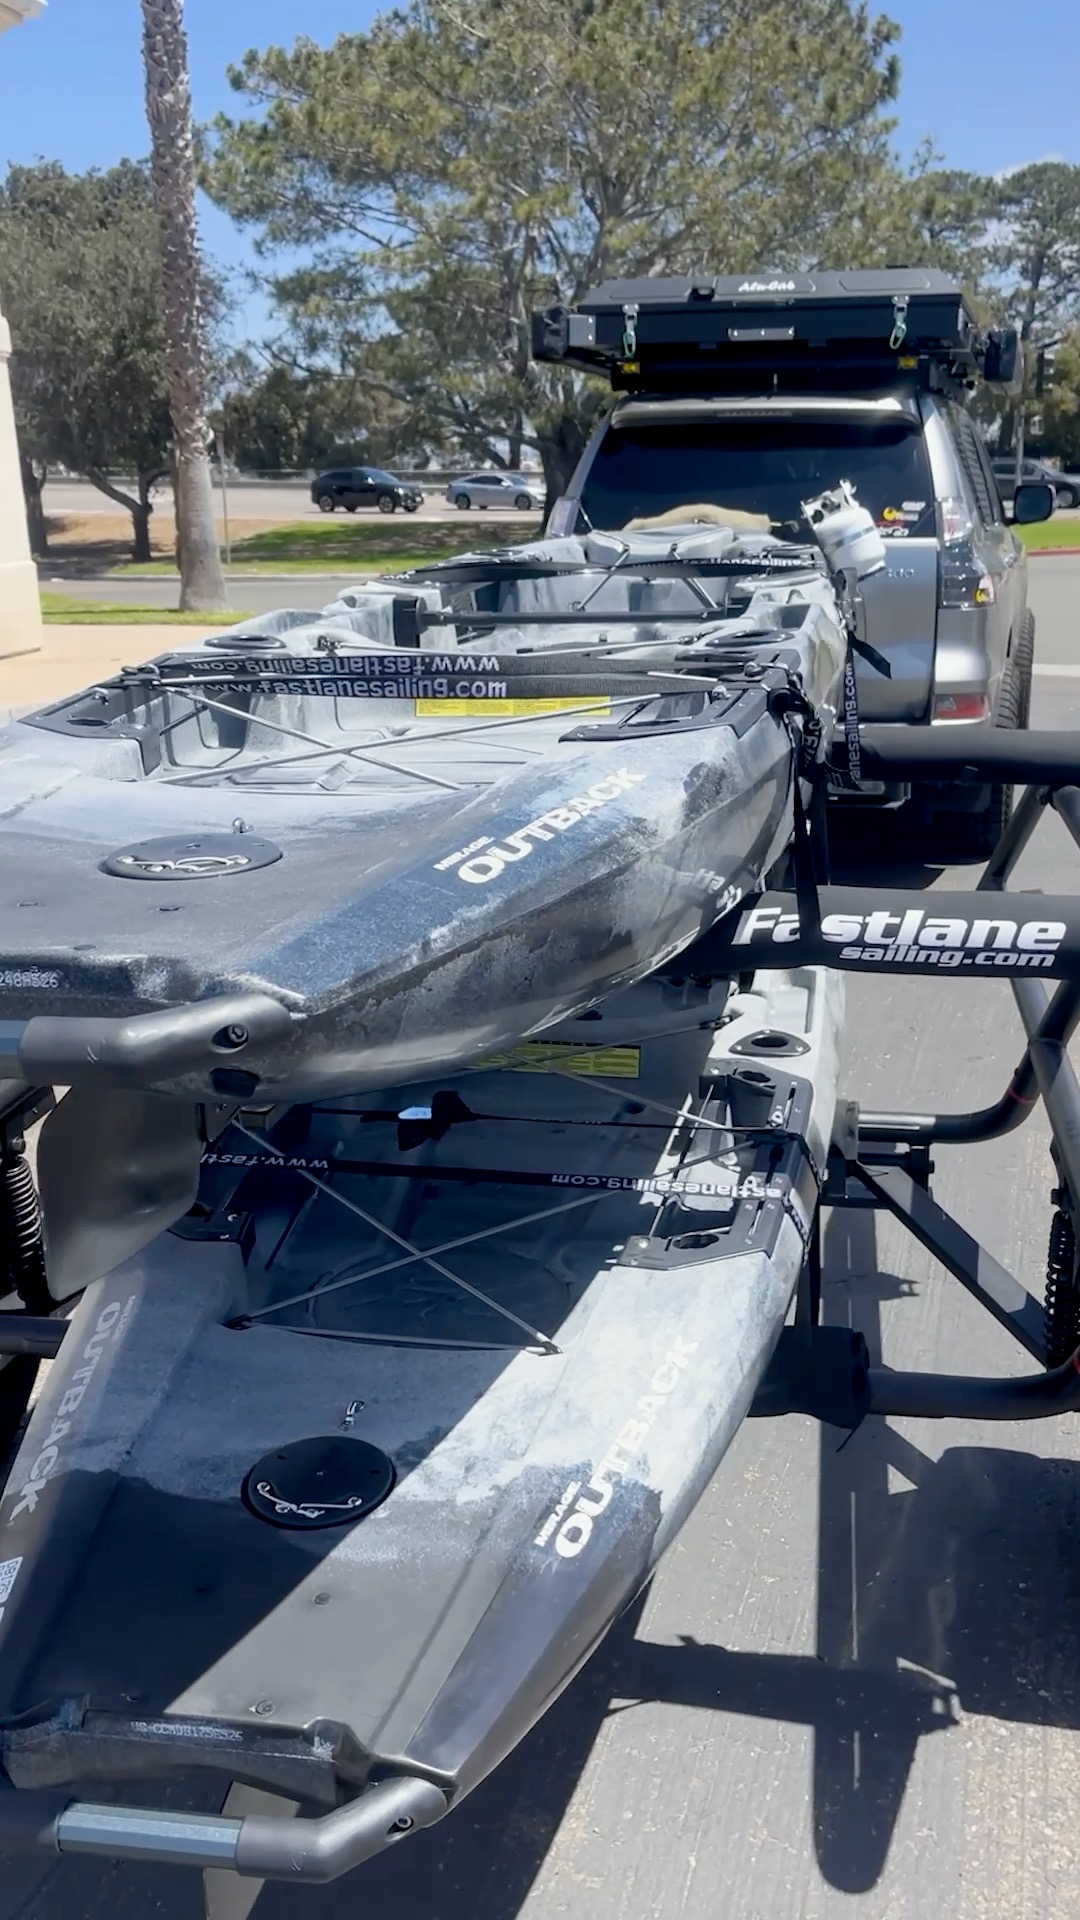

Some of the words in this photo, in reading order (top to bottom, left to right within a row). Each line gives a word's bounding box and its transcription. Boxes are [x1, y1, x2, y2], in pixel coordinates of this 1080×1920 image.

[190, 656, 501, 676] www.fastlanesailing.com
[458, 767, 648, 884] OUTBACK
[433, 835, 496, 871] MIRAGE
[731, 907, 1067, 950] Fastlane
[839, 944, 1056, 968] sailing.com
[200, 1154, 329, 1168] www.fastl
[552, 1174, 783, 1198] astlanesailing.com
[9, 1301, 121, 1522] OUTBACK
[555, 1335, 701, 1558] OUTBACK
[534, 1480, 582, 1547] MIRAGE
